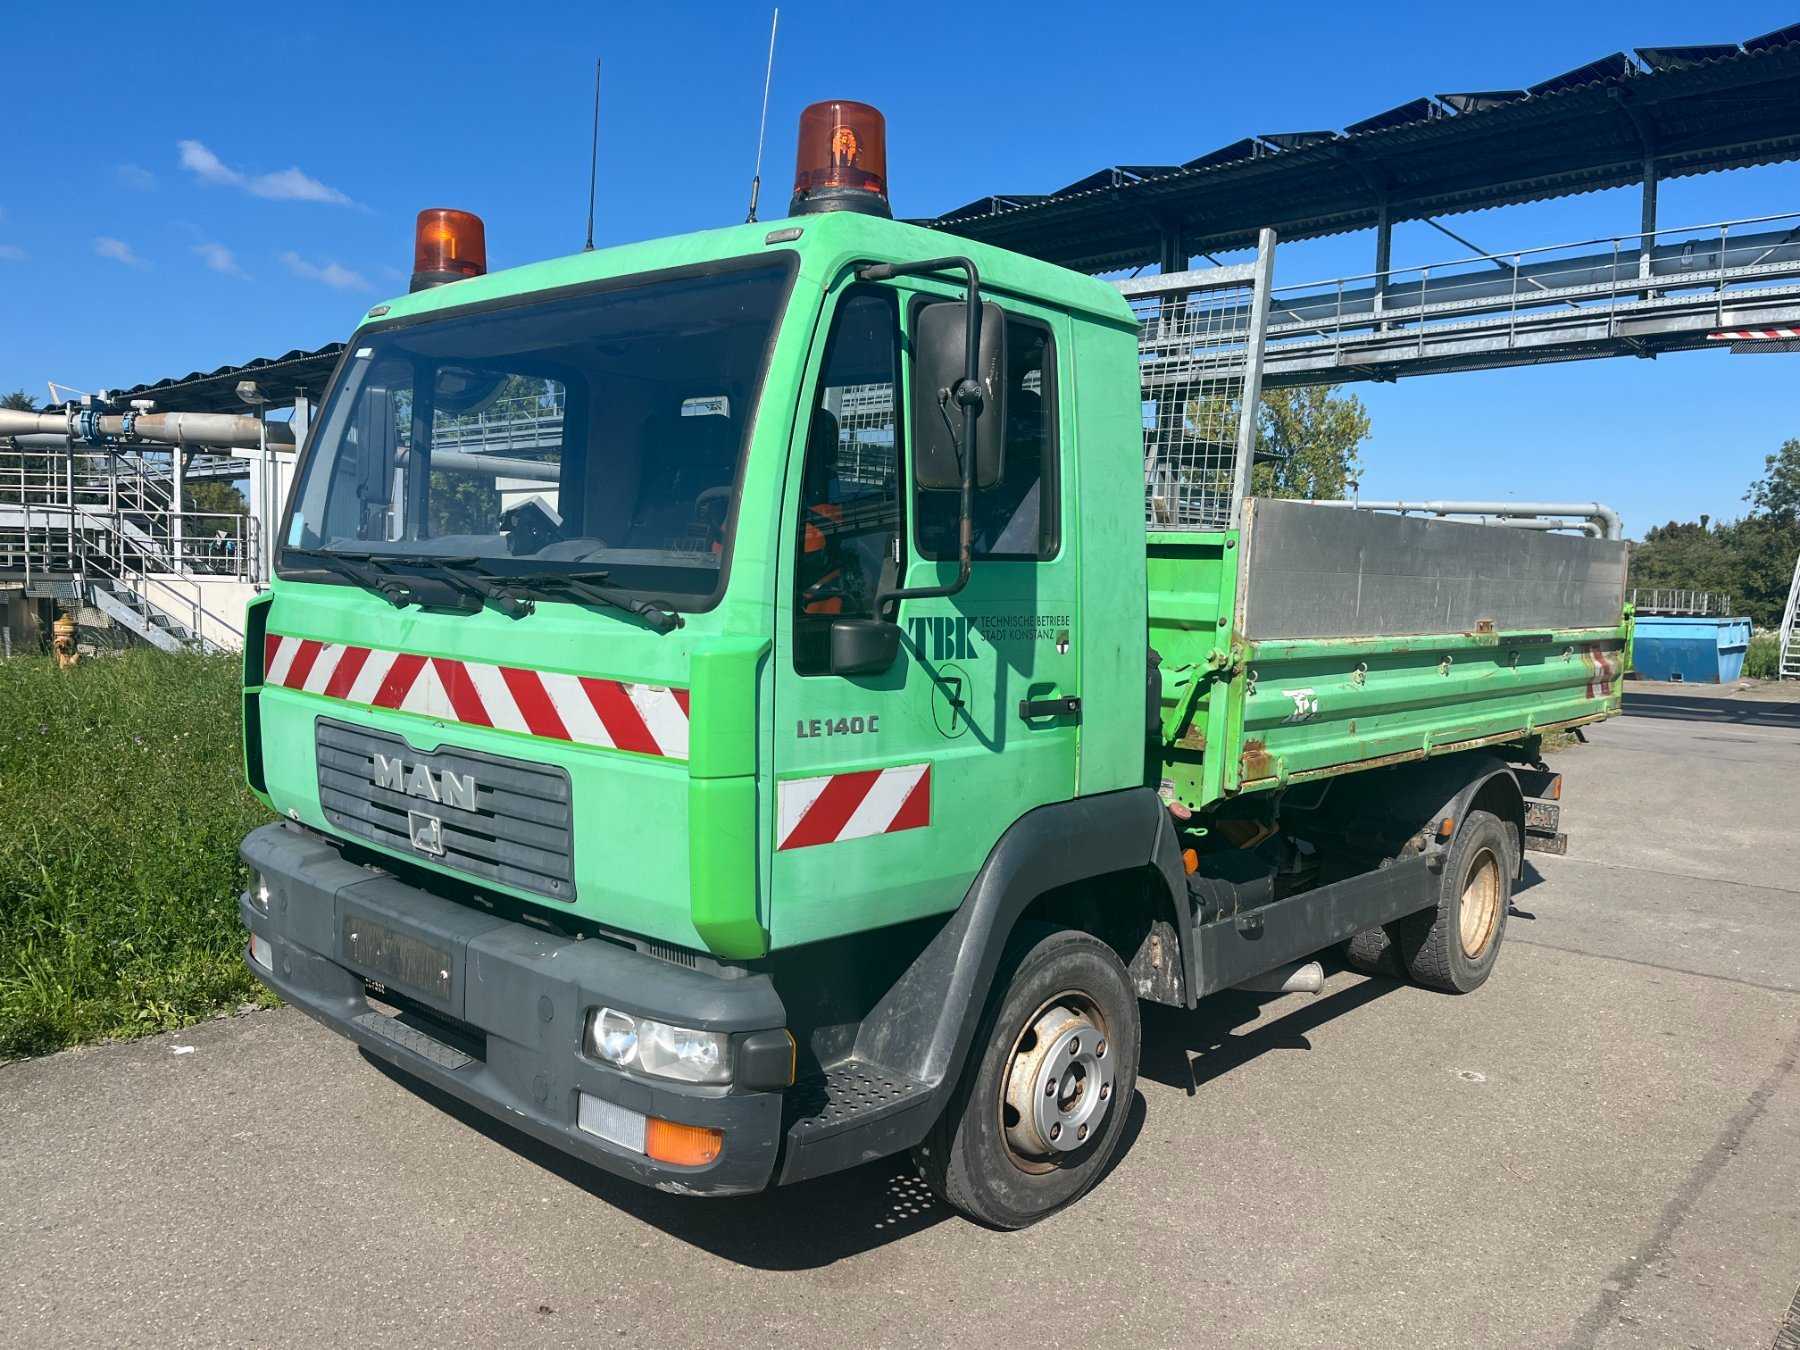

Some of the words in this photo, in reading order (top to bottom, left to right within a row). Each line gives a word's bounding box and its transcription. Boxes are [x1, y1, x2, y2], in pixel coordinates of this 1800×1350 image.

[980, 629, 1007, 641] STADT
[1009, 628, 1055, 641] KONSTANZ
[981, 615, 1034, 627] TECHNISCHE
[1036, 615, 1070, 627] BETRIEBE
[908, 616, 979, 661] TBK
[373, 753, 477, 812] MAN
